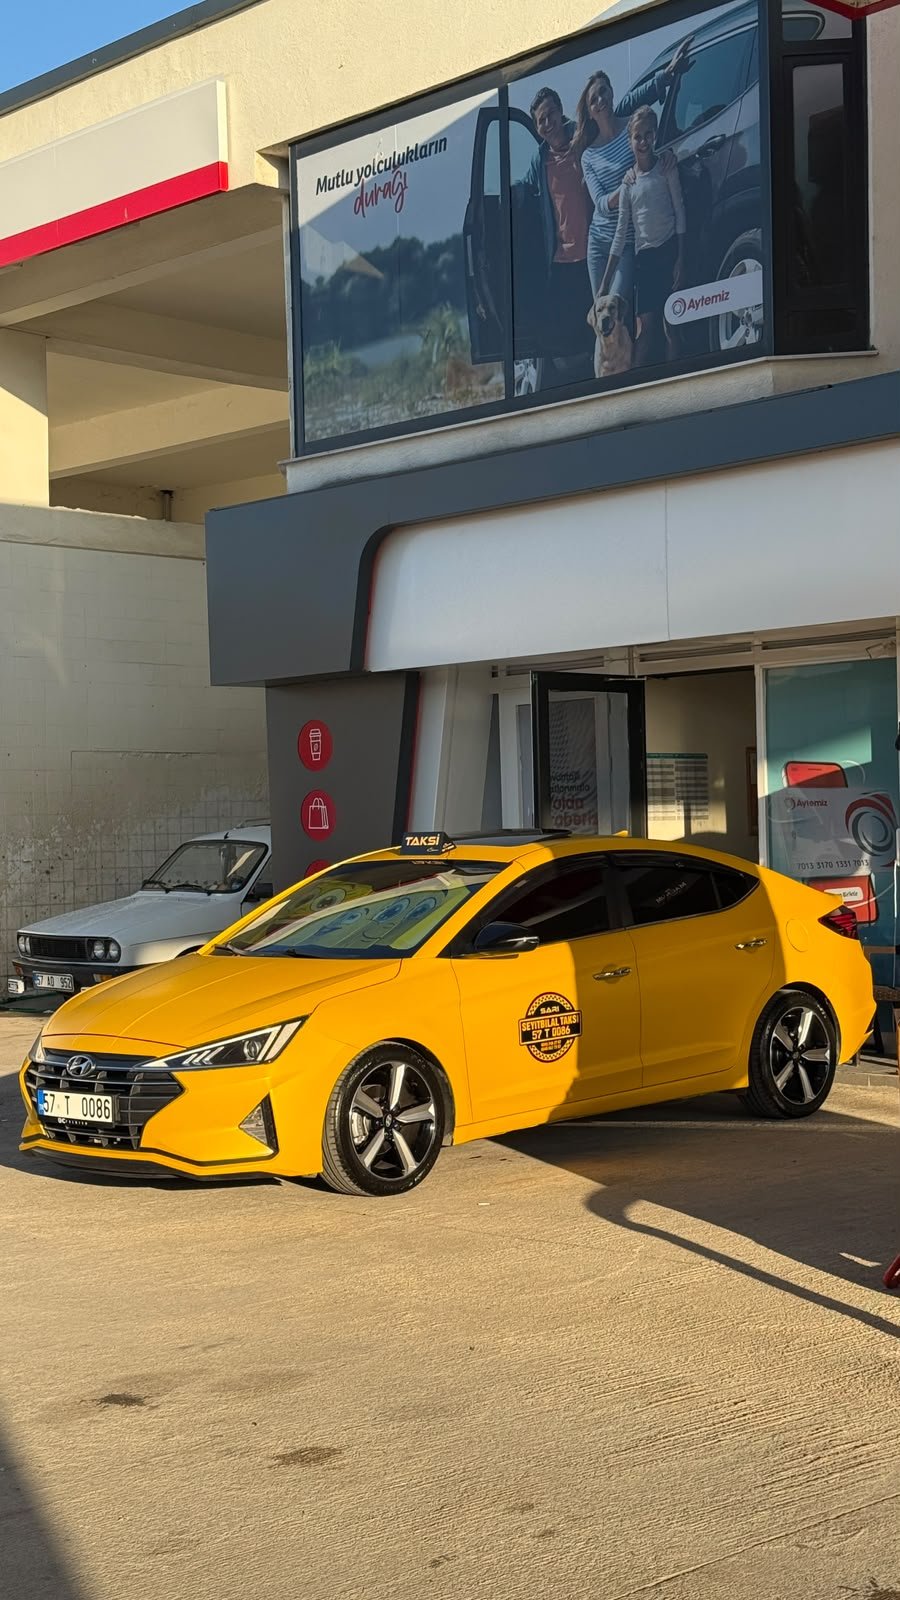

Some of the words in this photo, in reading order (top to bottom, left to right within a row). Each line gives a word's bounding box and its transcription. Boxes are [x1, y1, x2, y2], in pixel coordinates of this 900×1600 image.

[316, 169, 353, 195] Mutlu
[354, 137, 447, 187] yolculukların
[354, 168, 408, 217] durağı
[687, 290, 730, 311] Aytemiz
[796, 799, 828, 808] Aytemiz
[405, 834, 440, 846] TAKSİ
[798, 862, 814, 870] 7013
[817, 861, 833, 869] 3170
[540, 1006, 560, 1014] SARI
[532, 1029, 542, 1040] 57
[544, 1028, 550, 1038] T
[43, 1093, 55, 1112] 57
[65, 1095, 70, 1115] T
[82, 1097, 110, 1119] 0086
